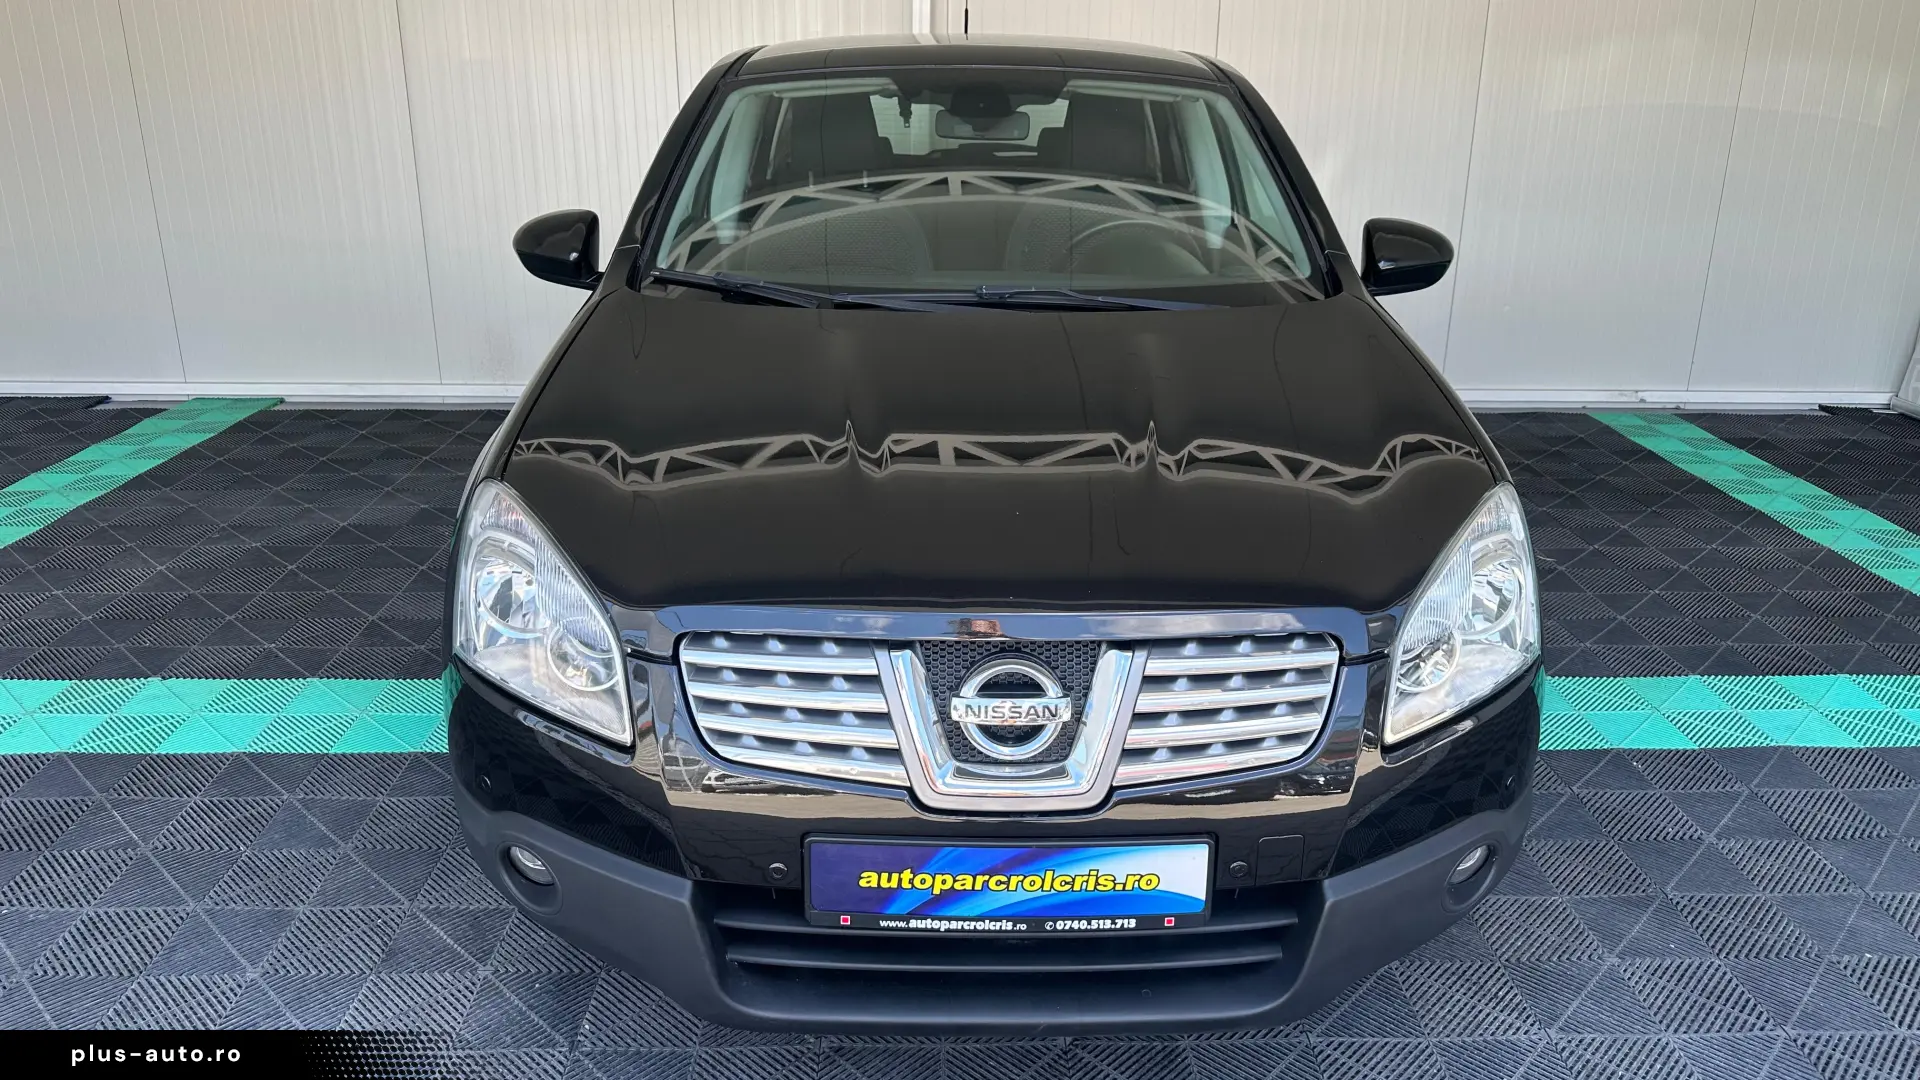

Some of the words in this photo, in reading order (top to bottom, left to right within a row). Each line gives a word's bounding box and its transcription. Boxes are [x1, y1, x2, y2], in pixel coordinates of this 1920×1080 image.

[965, 704, 1058, 719] NISSAN
[858, 868, 1160, 895] autoparcrolcris.ro
[879, 918, 1027, 931] www.autoparcrolcris.ro
[1055, 918, 1137, 930] 0740.513.713
